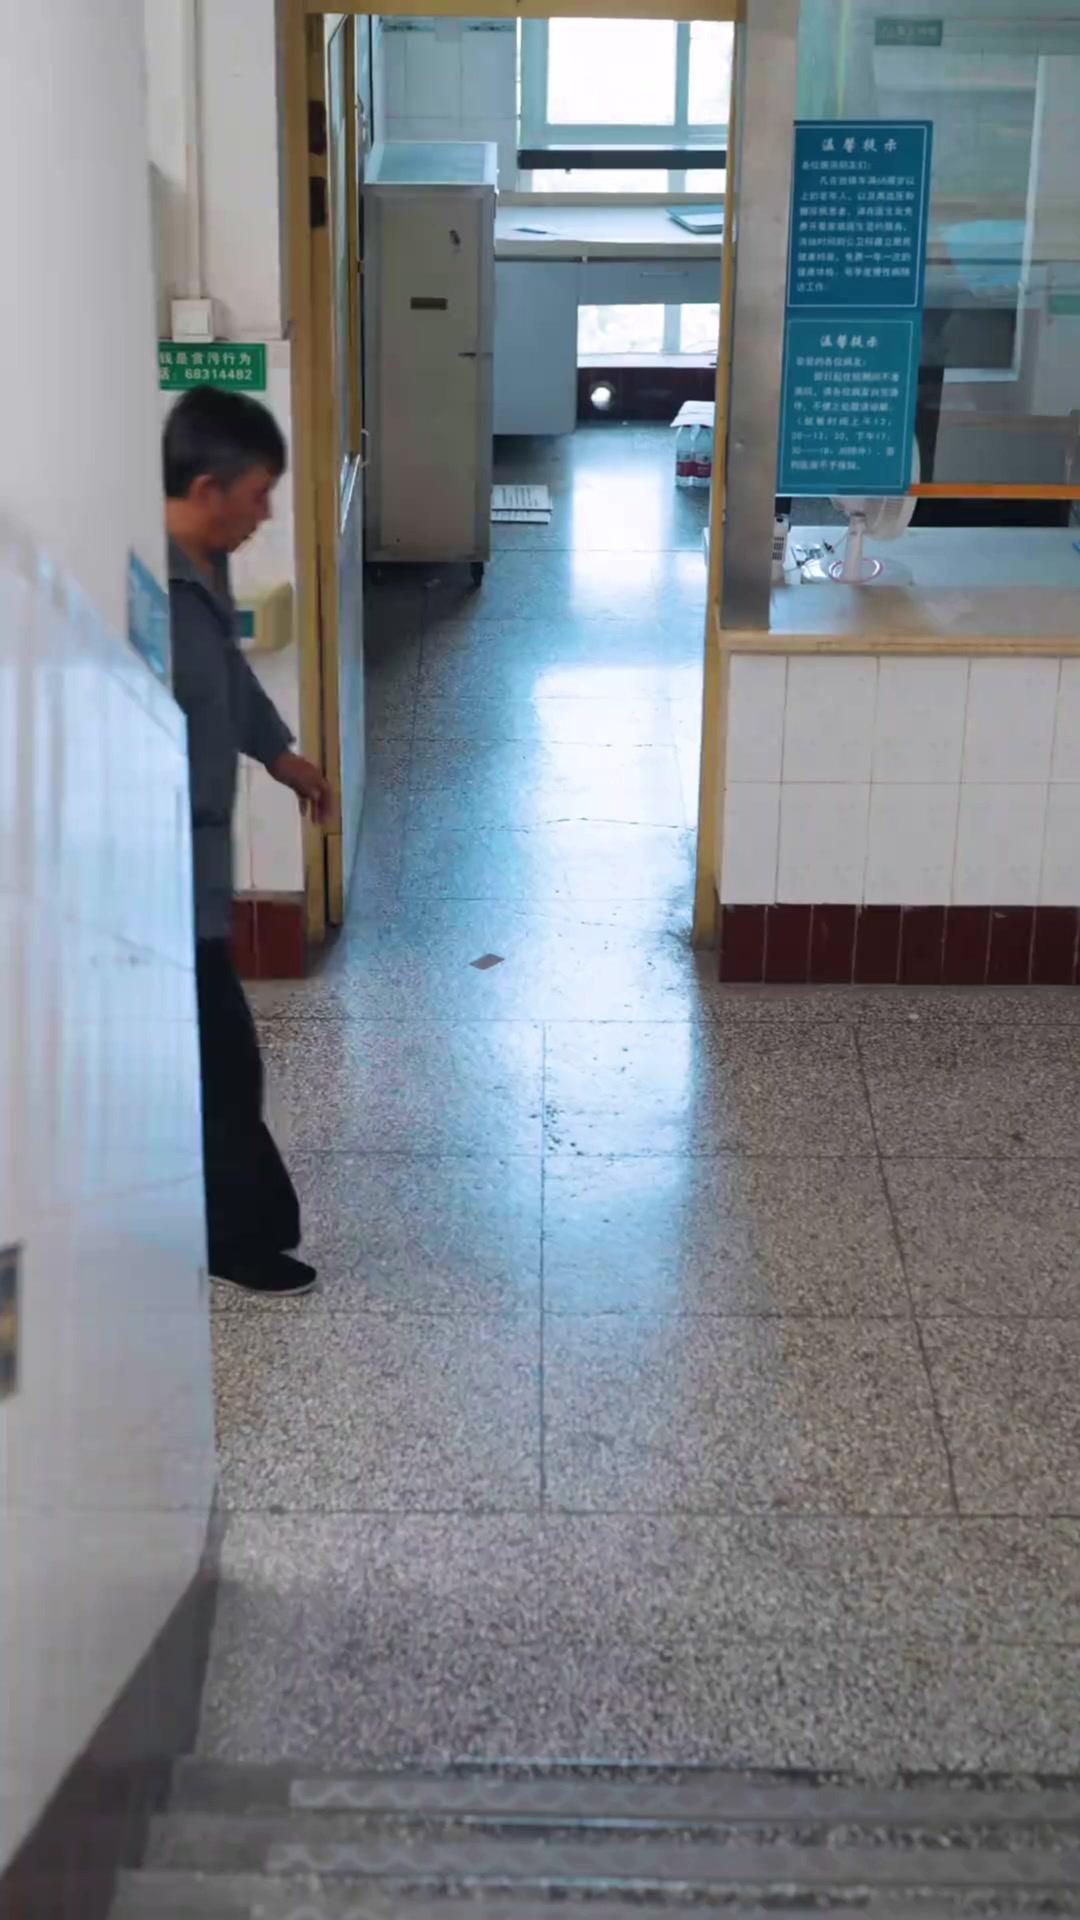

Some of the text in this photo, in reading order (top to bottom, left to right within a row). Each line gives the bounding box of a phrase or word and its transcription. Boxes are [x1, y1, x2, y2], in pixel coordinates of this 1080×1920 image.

[822, 138, 897, 153] 温馨提示
[820, 335, 878, 349] 温馨提示
